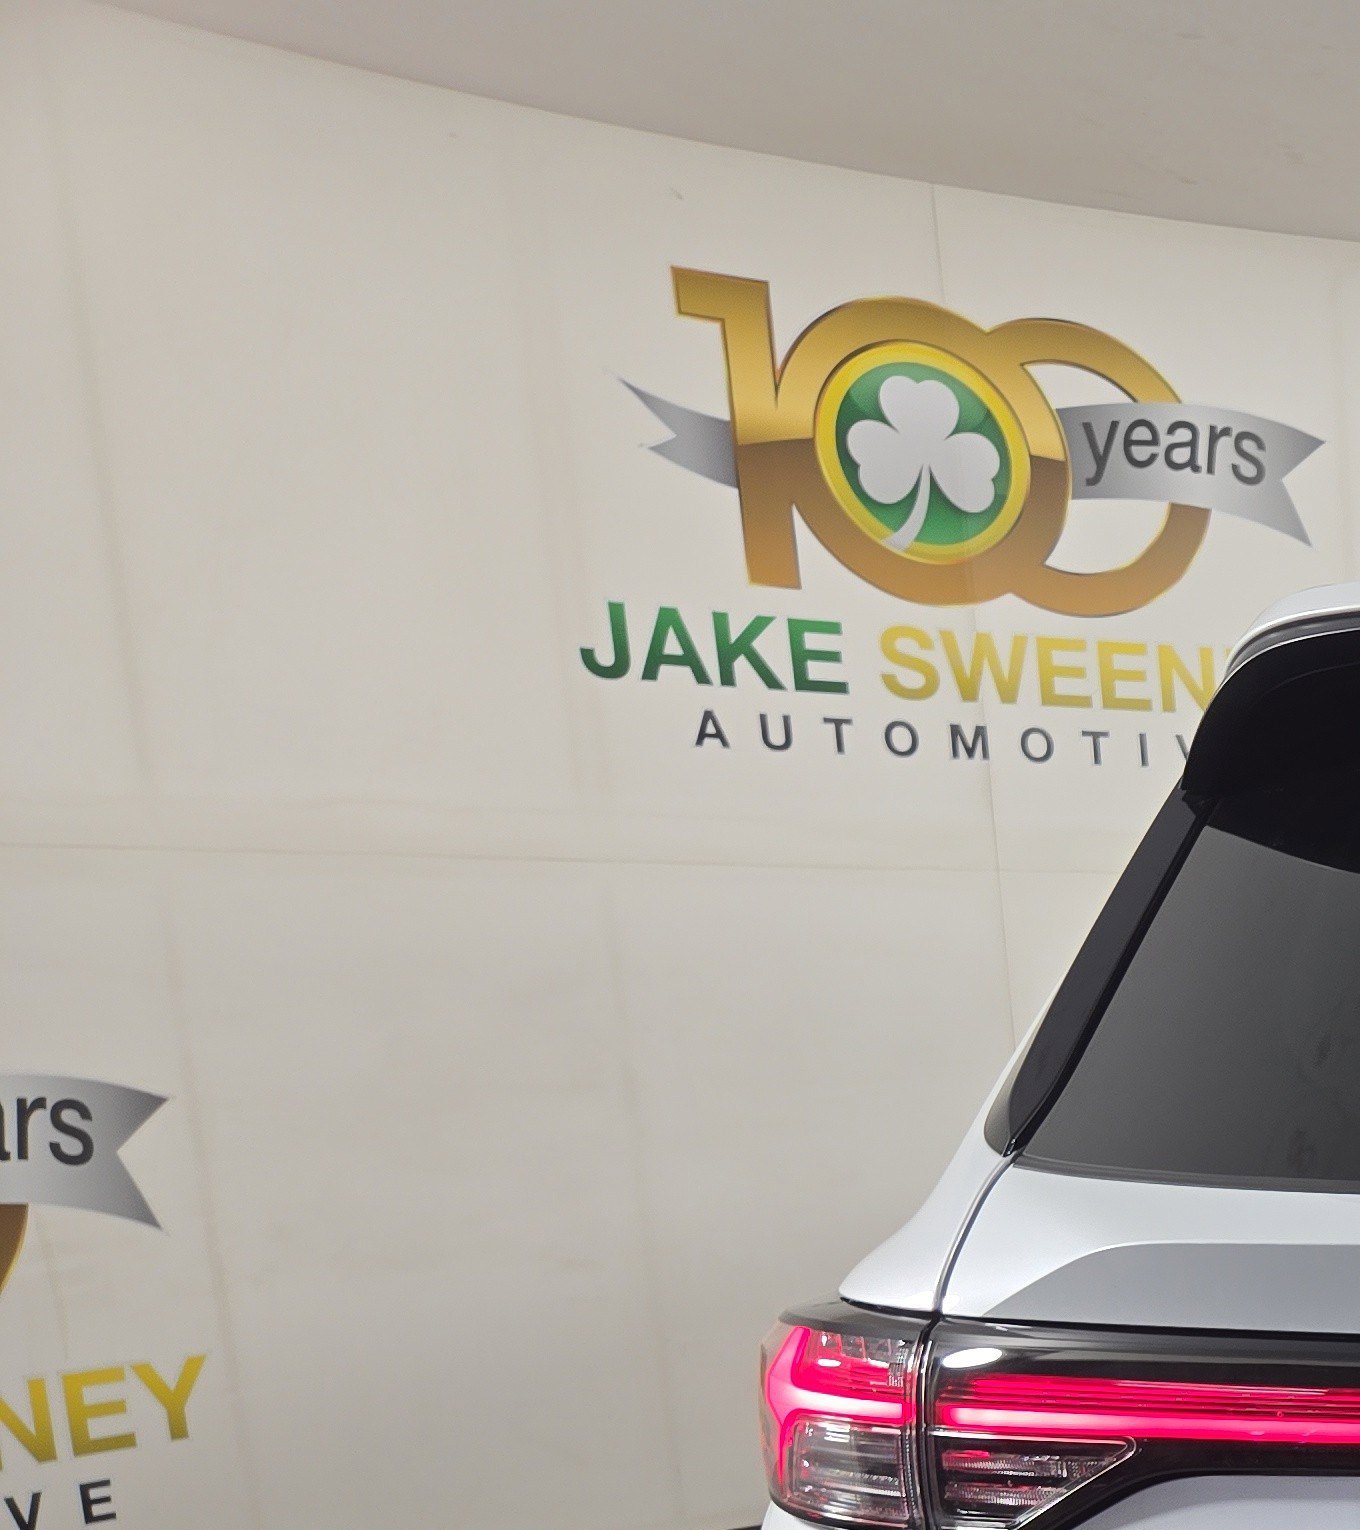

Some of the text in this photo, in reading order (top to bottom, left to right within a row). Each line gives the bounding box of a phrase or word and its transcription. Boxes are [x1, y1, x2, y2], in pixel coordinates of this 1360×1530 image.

[670, 265, 1212, 618] 100
[1082, 419, 1269, 486] years
[579, 600, 1232, 713] JAKE SWEEN
